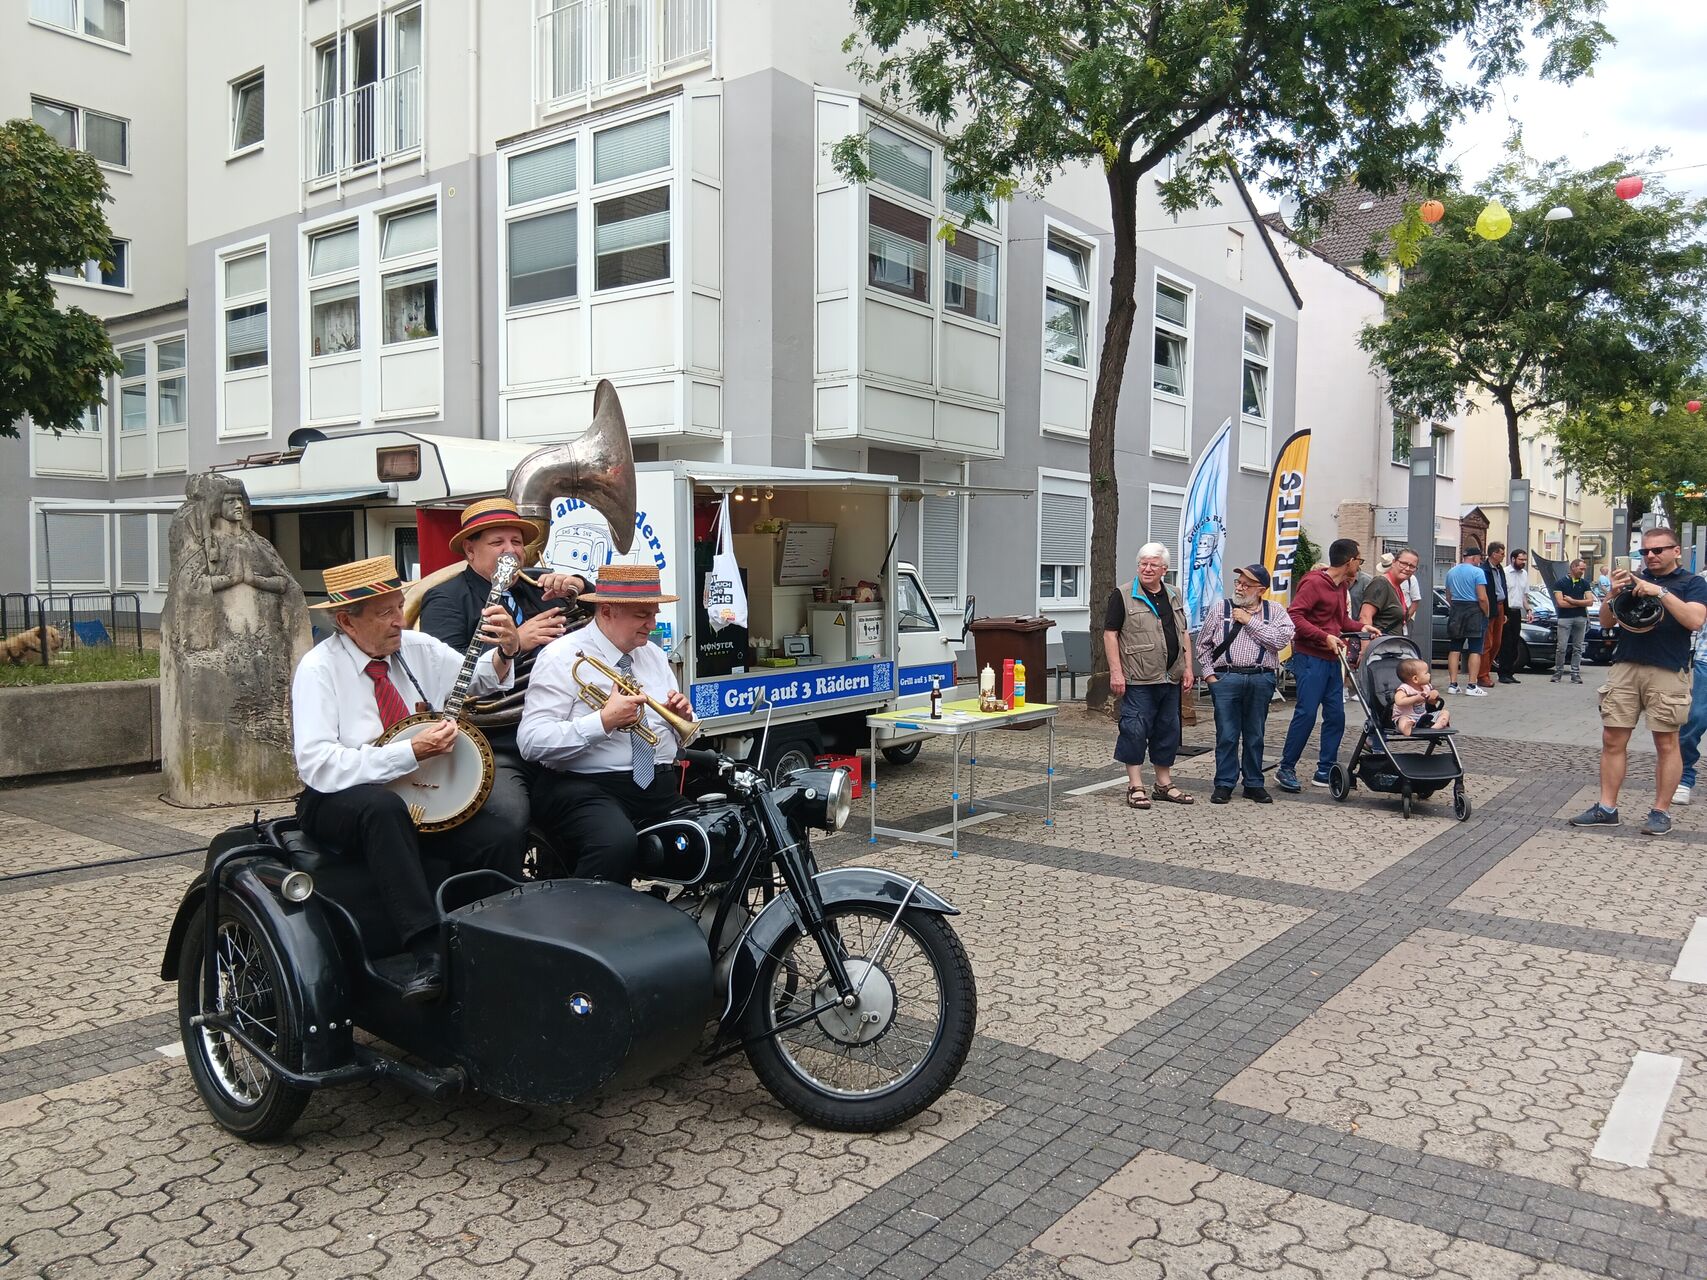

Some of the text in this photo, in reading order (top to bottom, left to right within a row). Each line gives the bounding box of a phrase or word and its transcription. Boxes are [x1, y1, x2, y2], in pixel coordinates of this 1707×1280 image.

[635, 511, 666, 570] dern
[700, 641, 734, 652] MONSTER
[724, 674, 870, 708] Grill auf 3 Rädern
[900, 677, 914, 686] Grill
[914, 676, 923, 684] auf
[924, 676, 928, 684] 3
